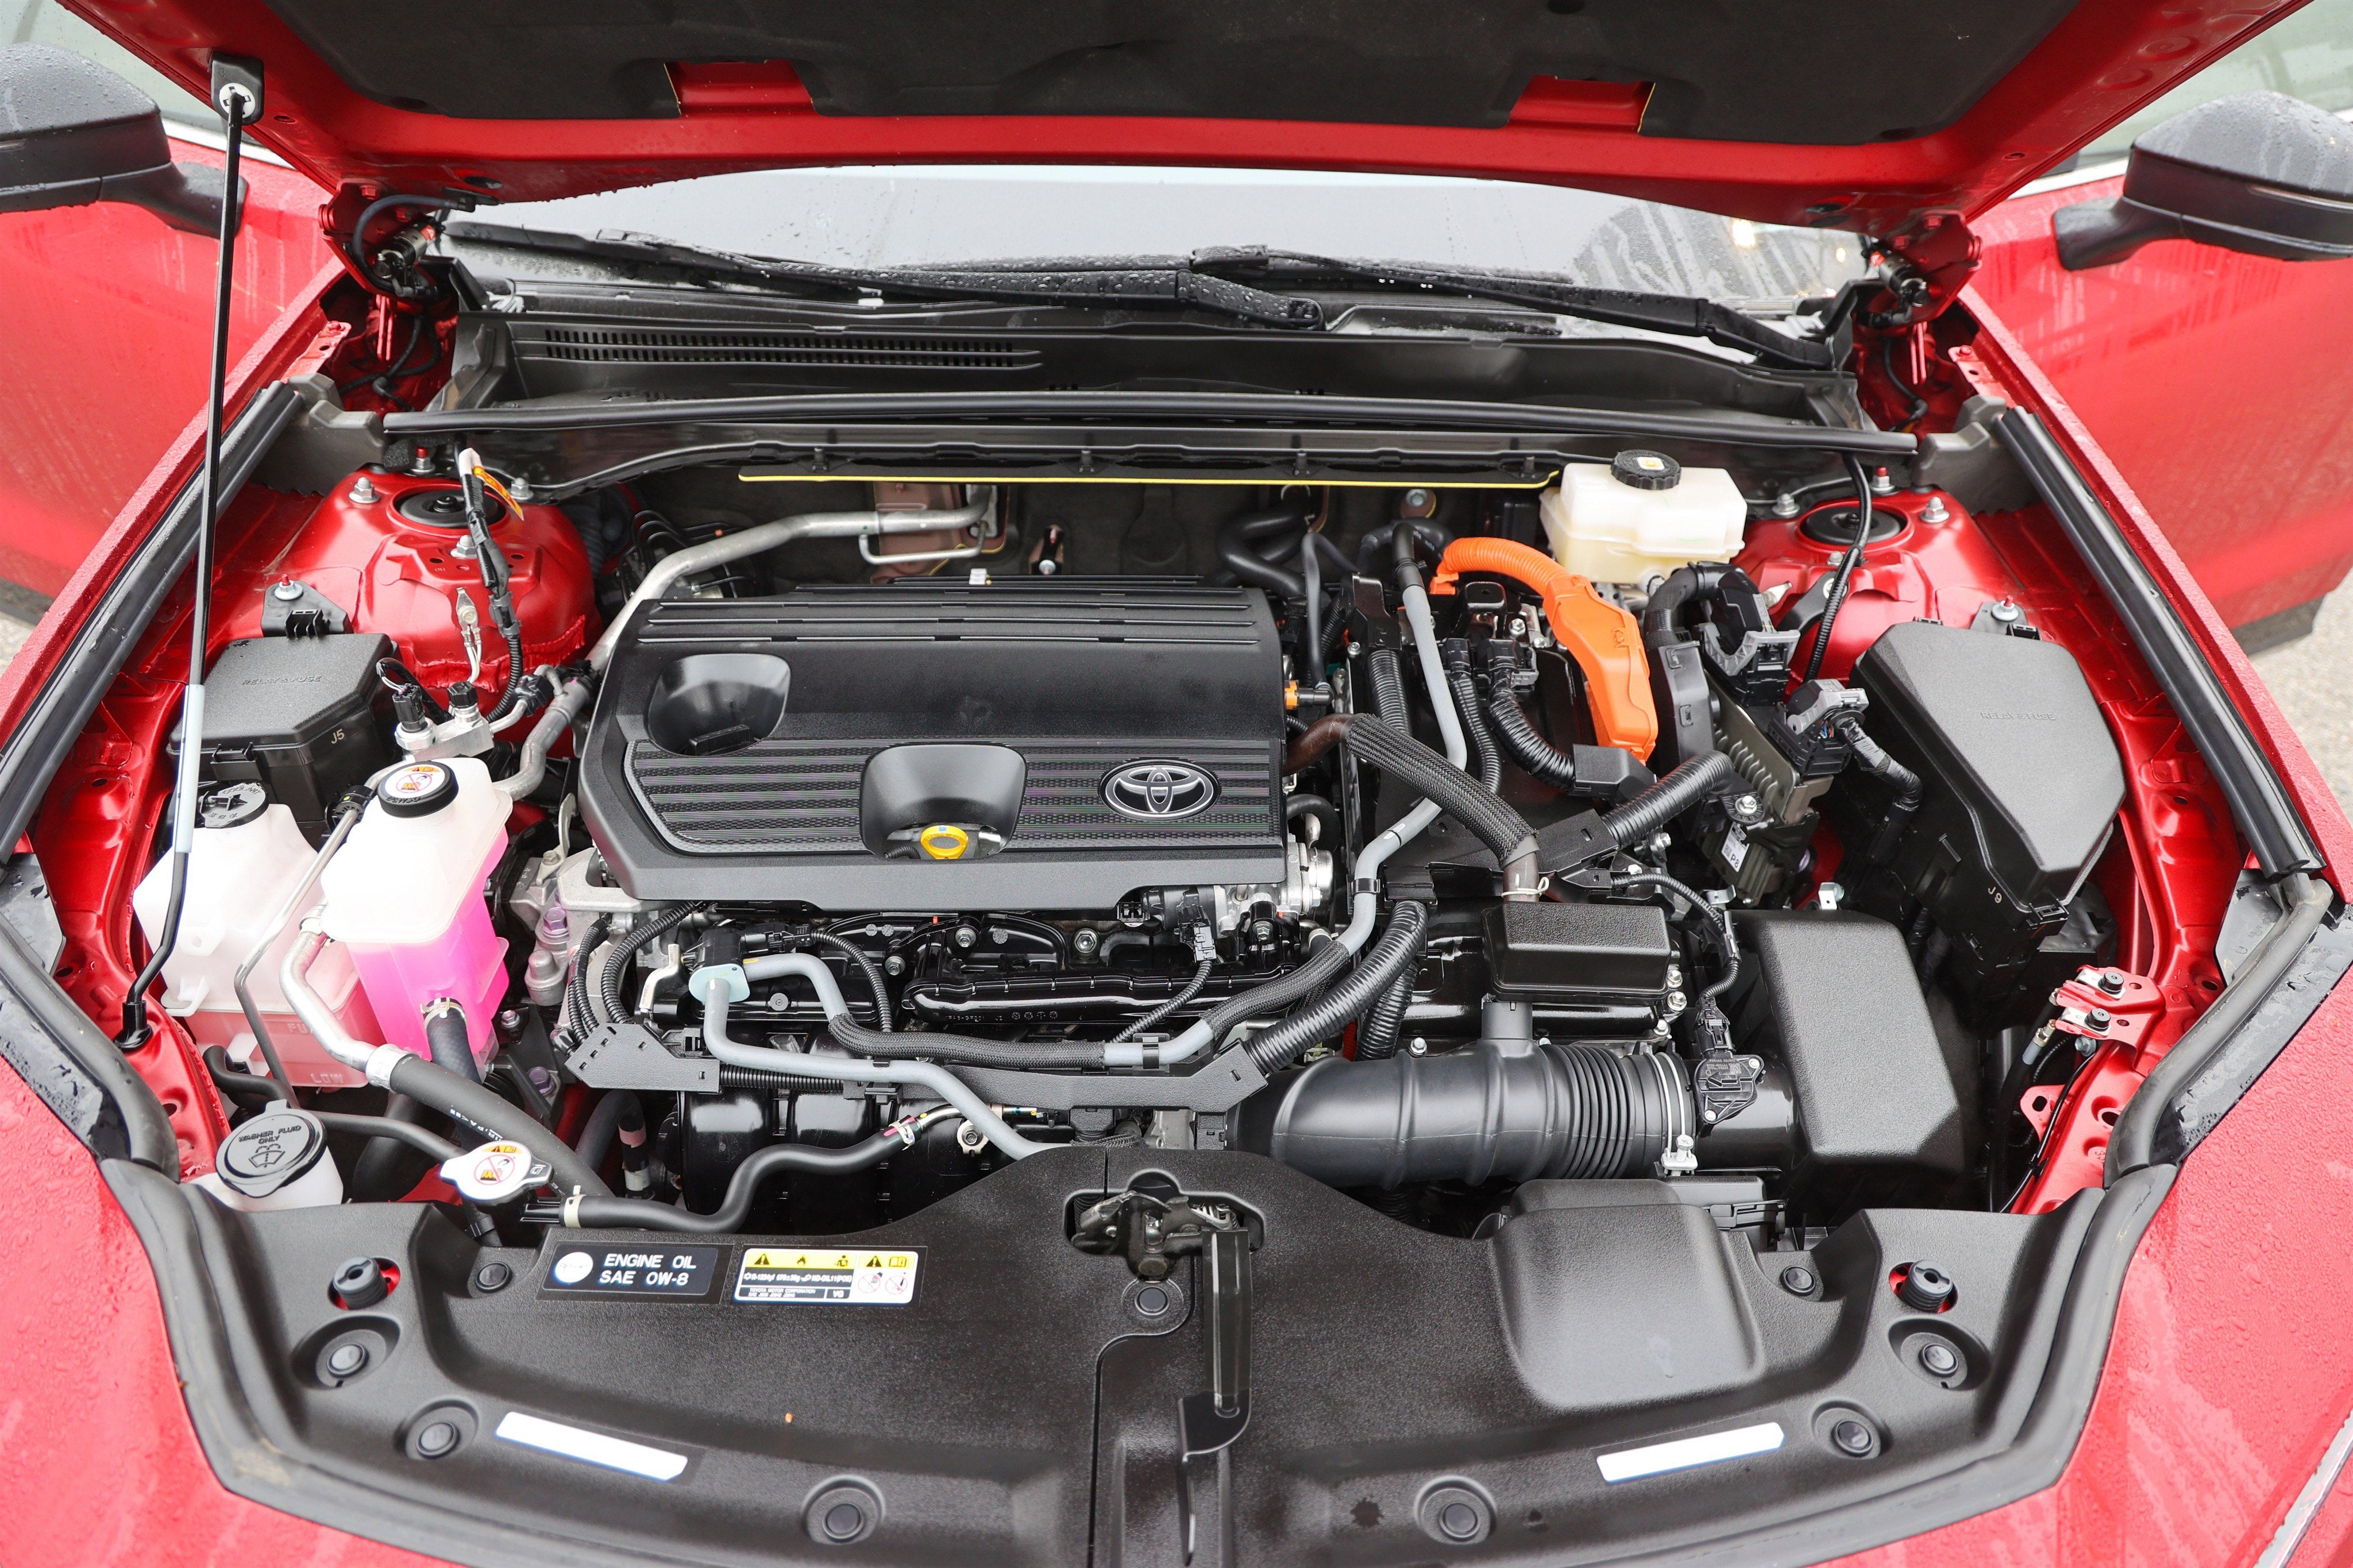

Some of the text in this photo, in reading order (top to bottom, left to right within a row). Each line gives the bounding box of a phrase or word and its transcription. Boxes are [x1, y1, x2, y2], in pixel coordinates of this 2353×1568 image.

[241, 677, 280, 685] RELAY
[1981, 711, 2014, 719] RELAY
[2027, 712, 2056, 720] FUSE
[331, 728, 345, 744] J5
[1988, 887, 2002, 903] J9
[310, 1073, 344, 1084] LOW
[238, 1125, 301, 1142] WASHER FLUID
[258, 1135, 280, 1144] ONLY
[604, 1253, 697, 1269] ENGINE OIL
[600, 1270, 689, 1286] SAE 0W-8
[832, 1289, 844, 1298] VG
